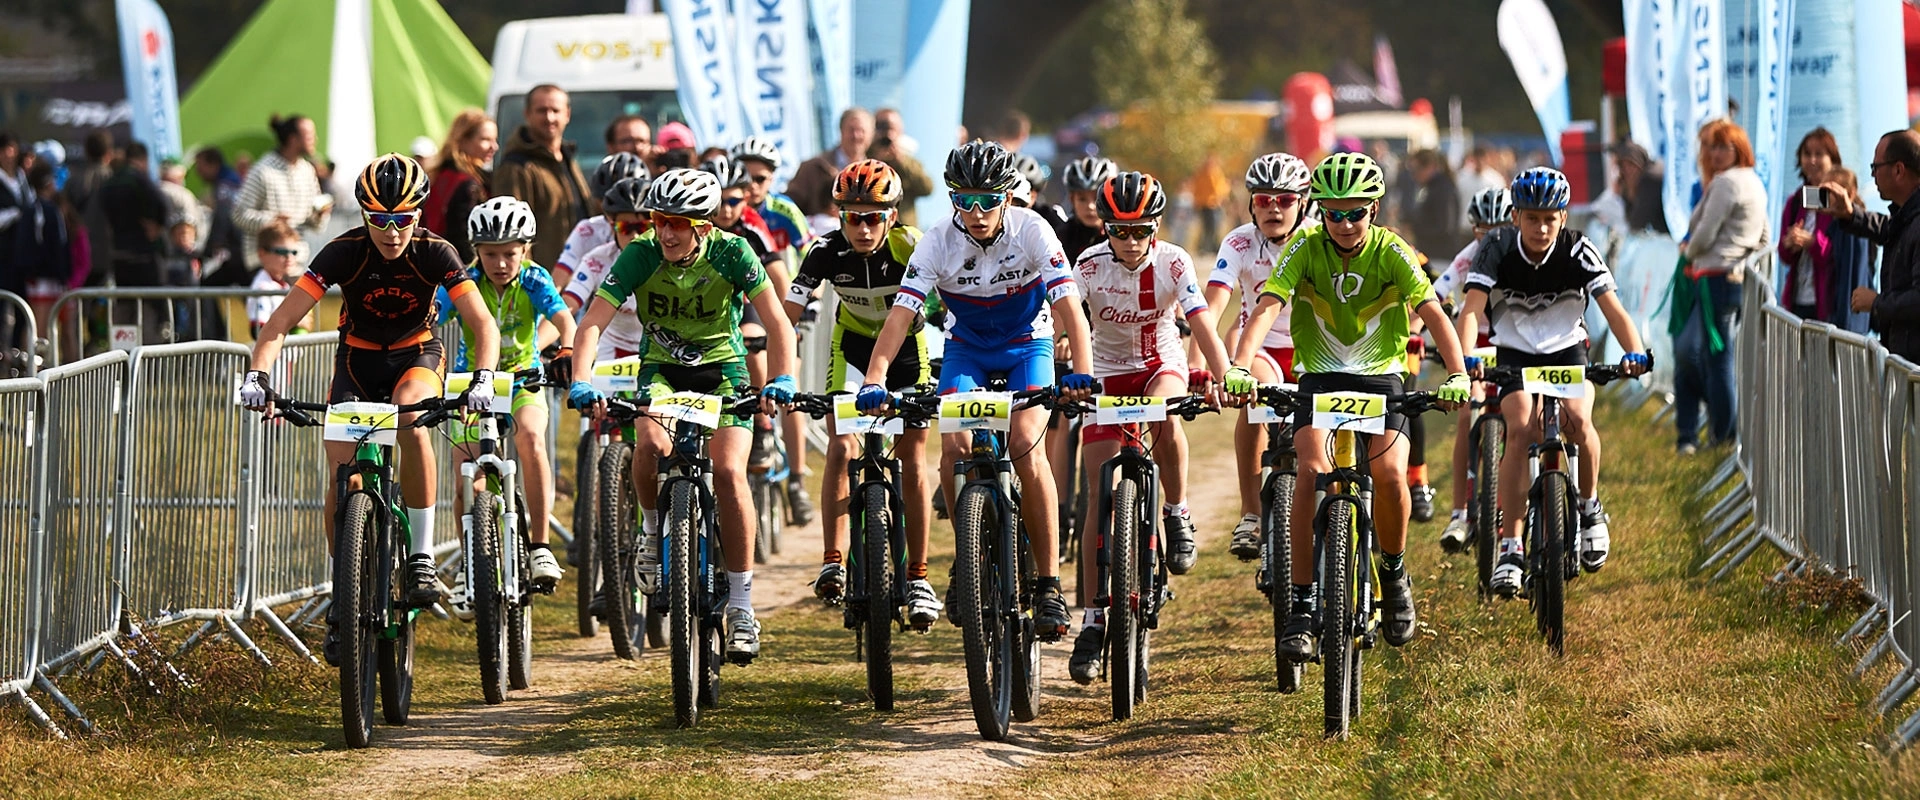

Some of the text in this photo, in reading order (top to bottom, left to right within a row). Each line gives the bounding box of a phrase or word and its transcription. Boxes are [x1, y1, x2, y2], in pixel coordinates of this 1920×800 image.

[957, 276, 981, 286] BTC
[990, 269, 1031, 285] CASTA
[648, 292, 716, 320] BKL
[1100, 306, 1165, 324] Château
[611, 364, 634, 376] 91
[1538, 369, 1572, 385] 466
[667, 397, 706, 410] 323
[957, 401, 997, 418] 105
[1329, 397, 1371, 416] 227
